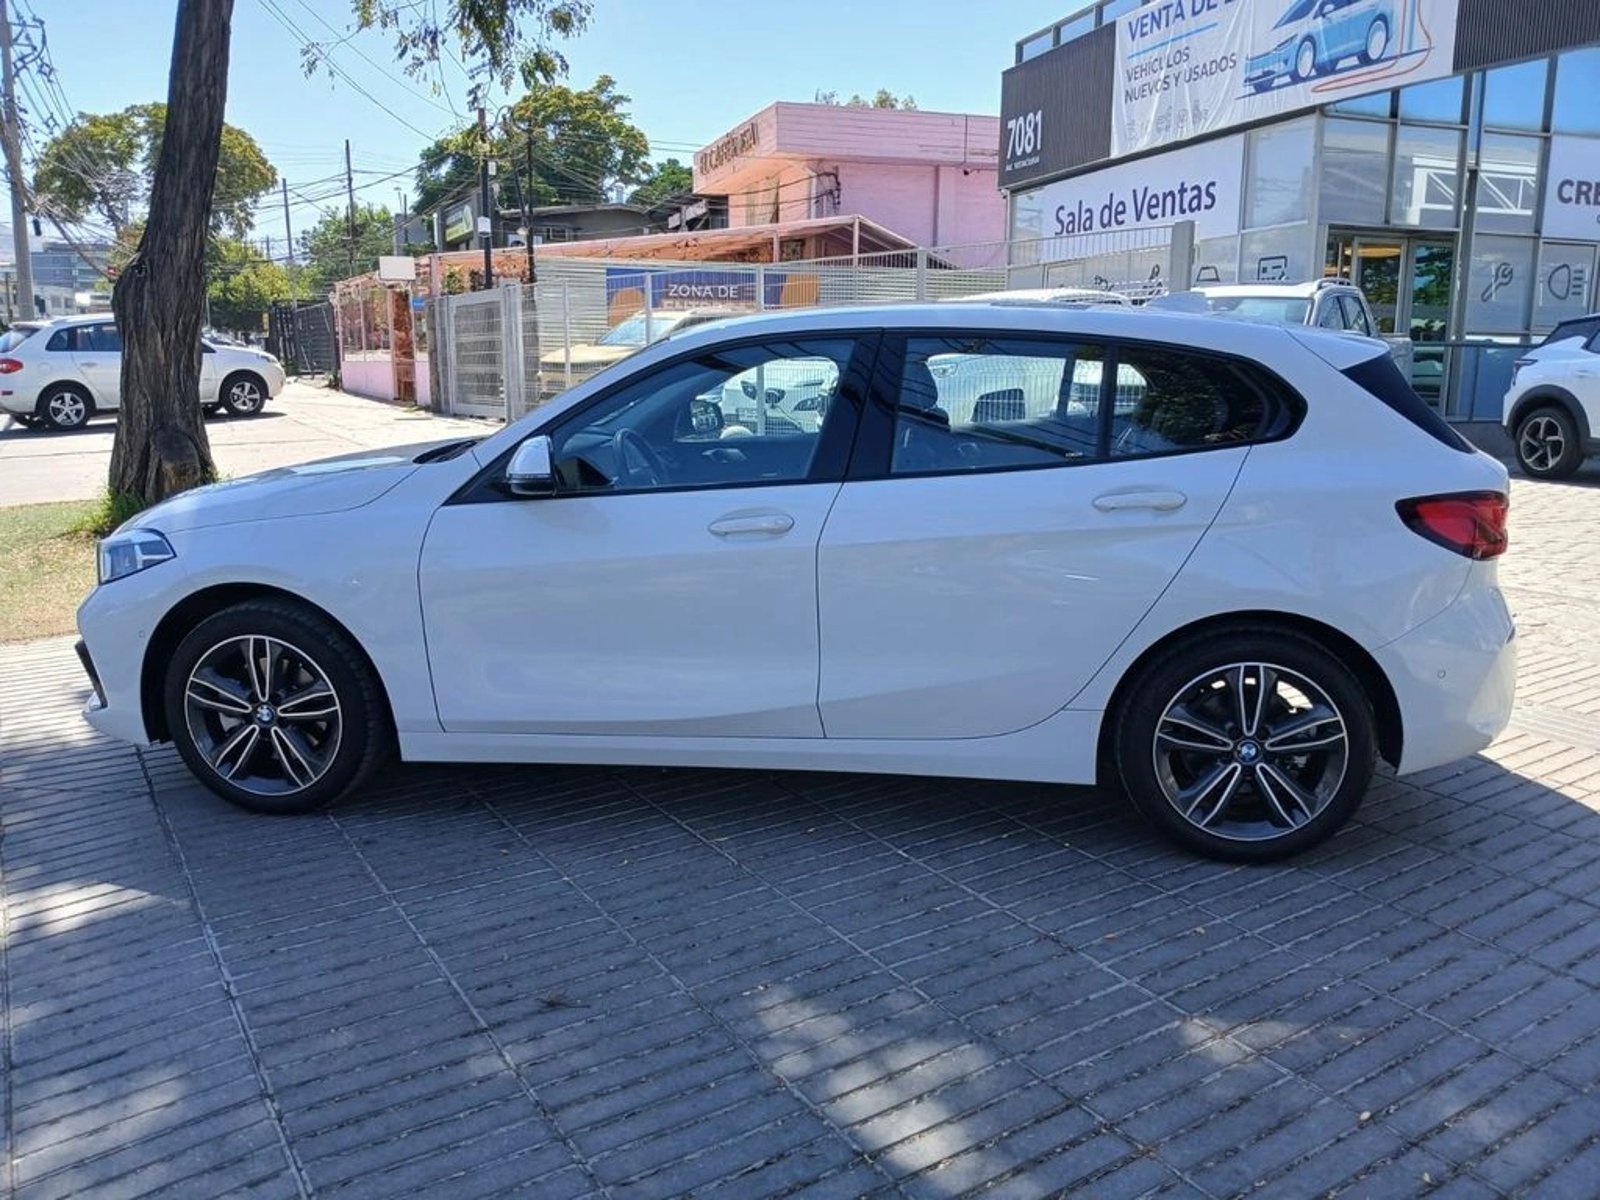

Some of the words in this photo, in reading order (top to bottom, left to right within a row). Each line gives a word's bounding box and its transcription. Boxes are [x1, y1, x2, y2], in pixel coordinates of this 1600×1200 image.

[1128, 0, 1186, 41] VENTA
[1124, 75, 1171, 104] NUEVOS
[1173, 71, 1182, 87] Y
[1184, 52, 1237, 83] USADOS
[1007, 109, 1042, 159] 7081
[1054, 200, 1094, 236] Sala
[1100, 192, 1127, 229] de
[1132, 180, 1217, 222] Ventas
[667, 284, 713, 297] ZONA
[718, 285, 739, 298] DE
